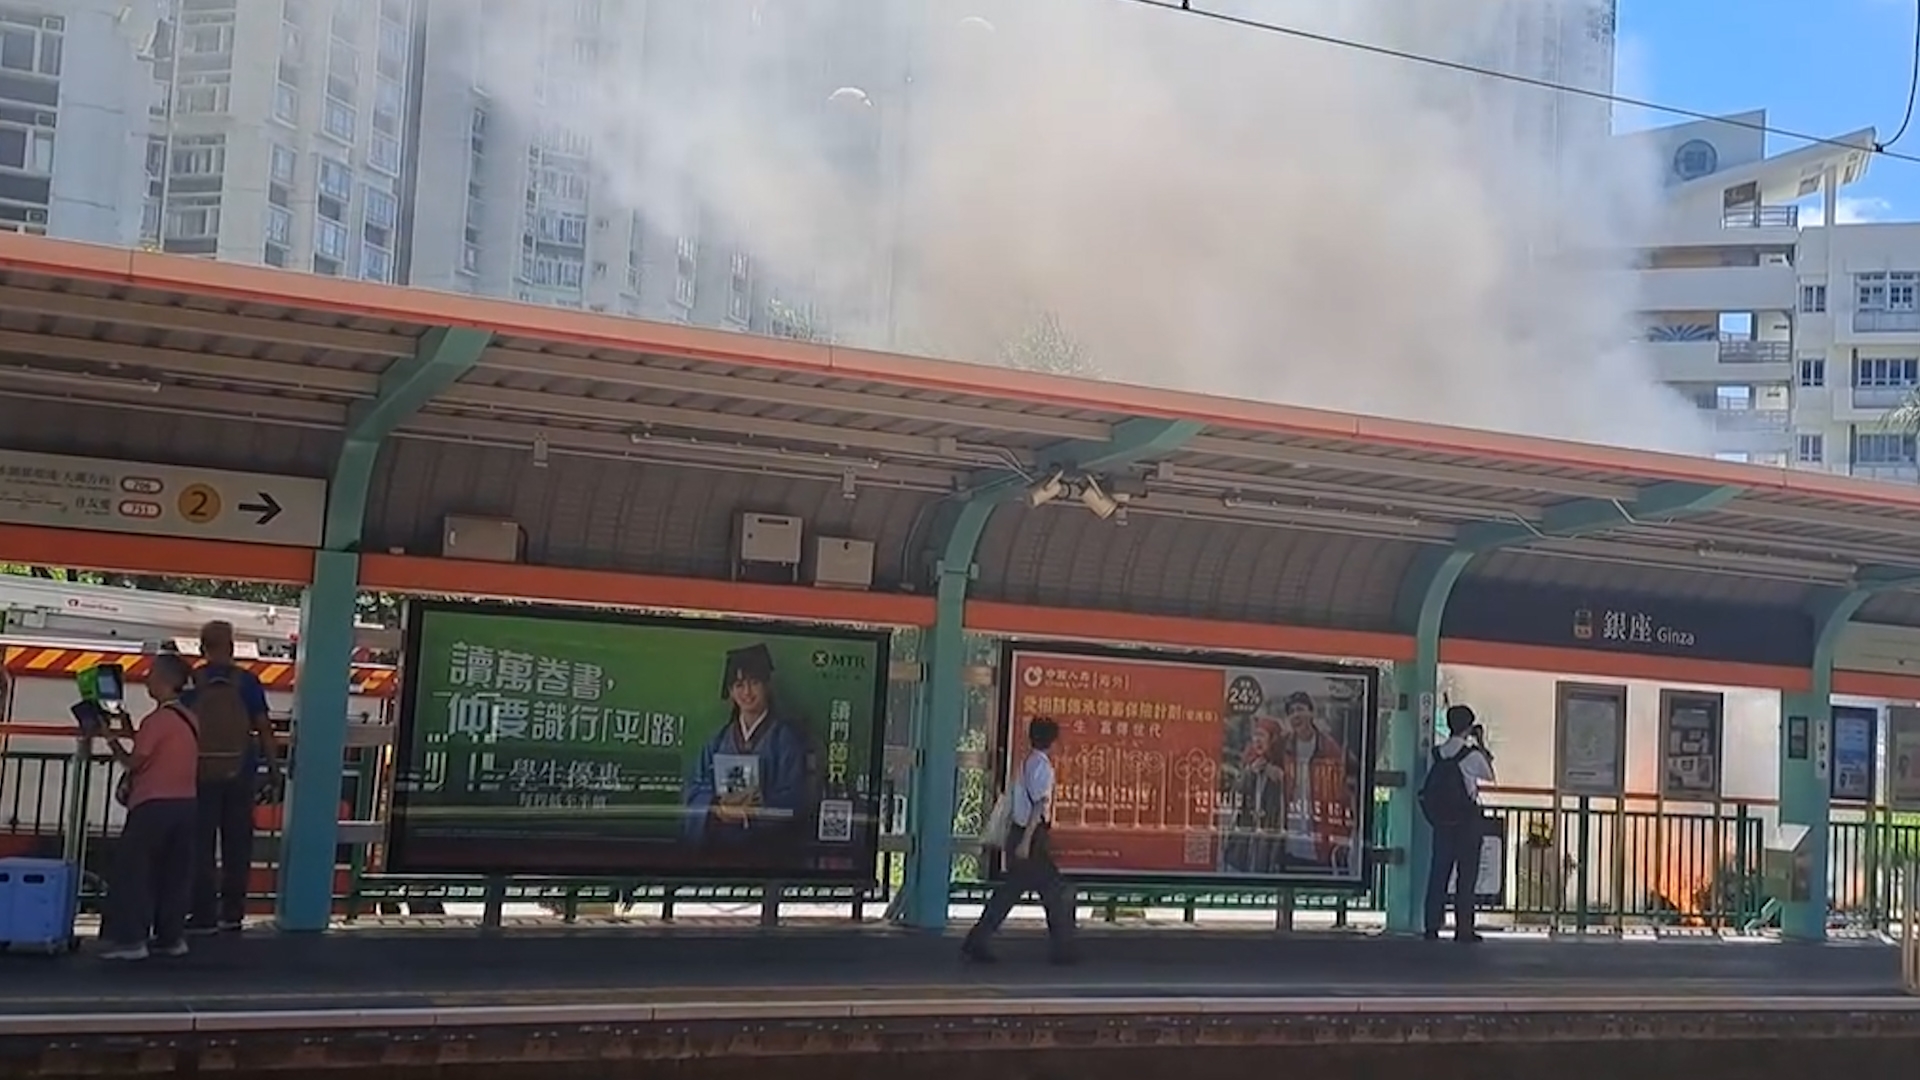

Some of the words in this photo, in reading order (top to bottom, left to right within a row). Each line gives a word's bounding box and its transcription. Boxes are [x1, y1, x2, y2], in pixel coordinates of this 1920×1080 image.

[190, 490, 208, 516] 2
[1603, 610, 1652, 642] 銀座
[1657, 627, 1695, 645] Ginza
[831, 654, 866, 669] MTR
[1228, 687, 1261, 705] 24%
